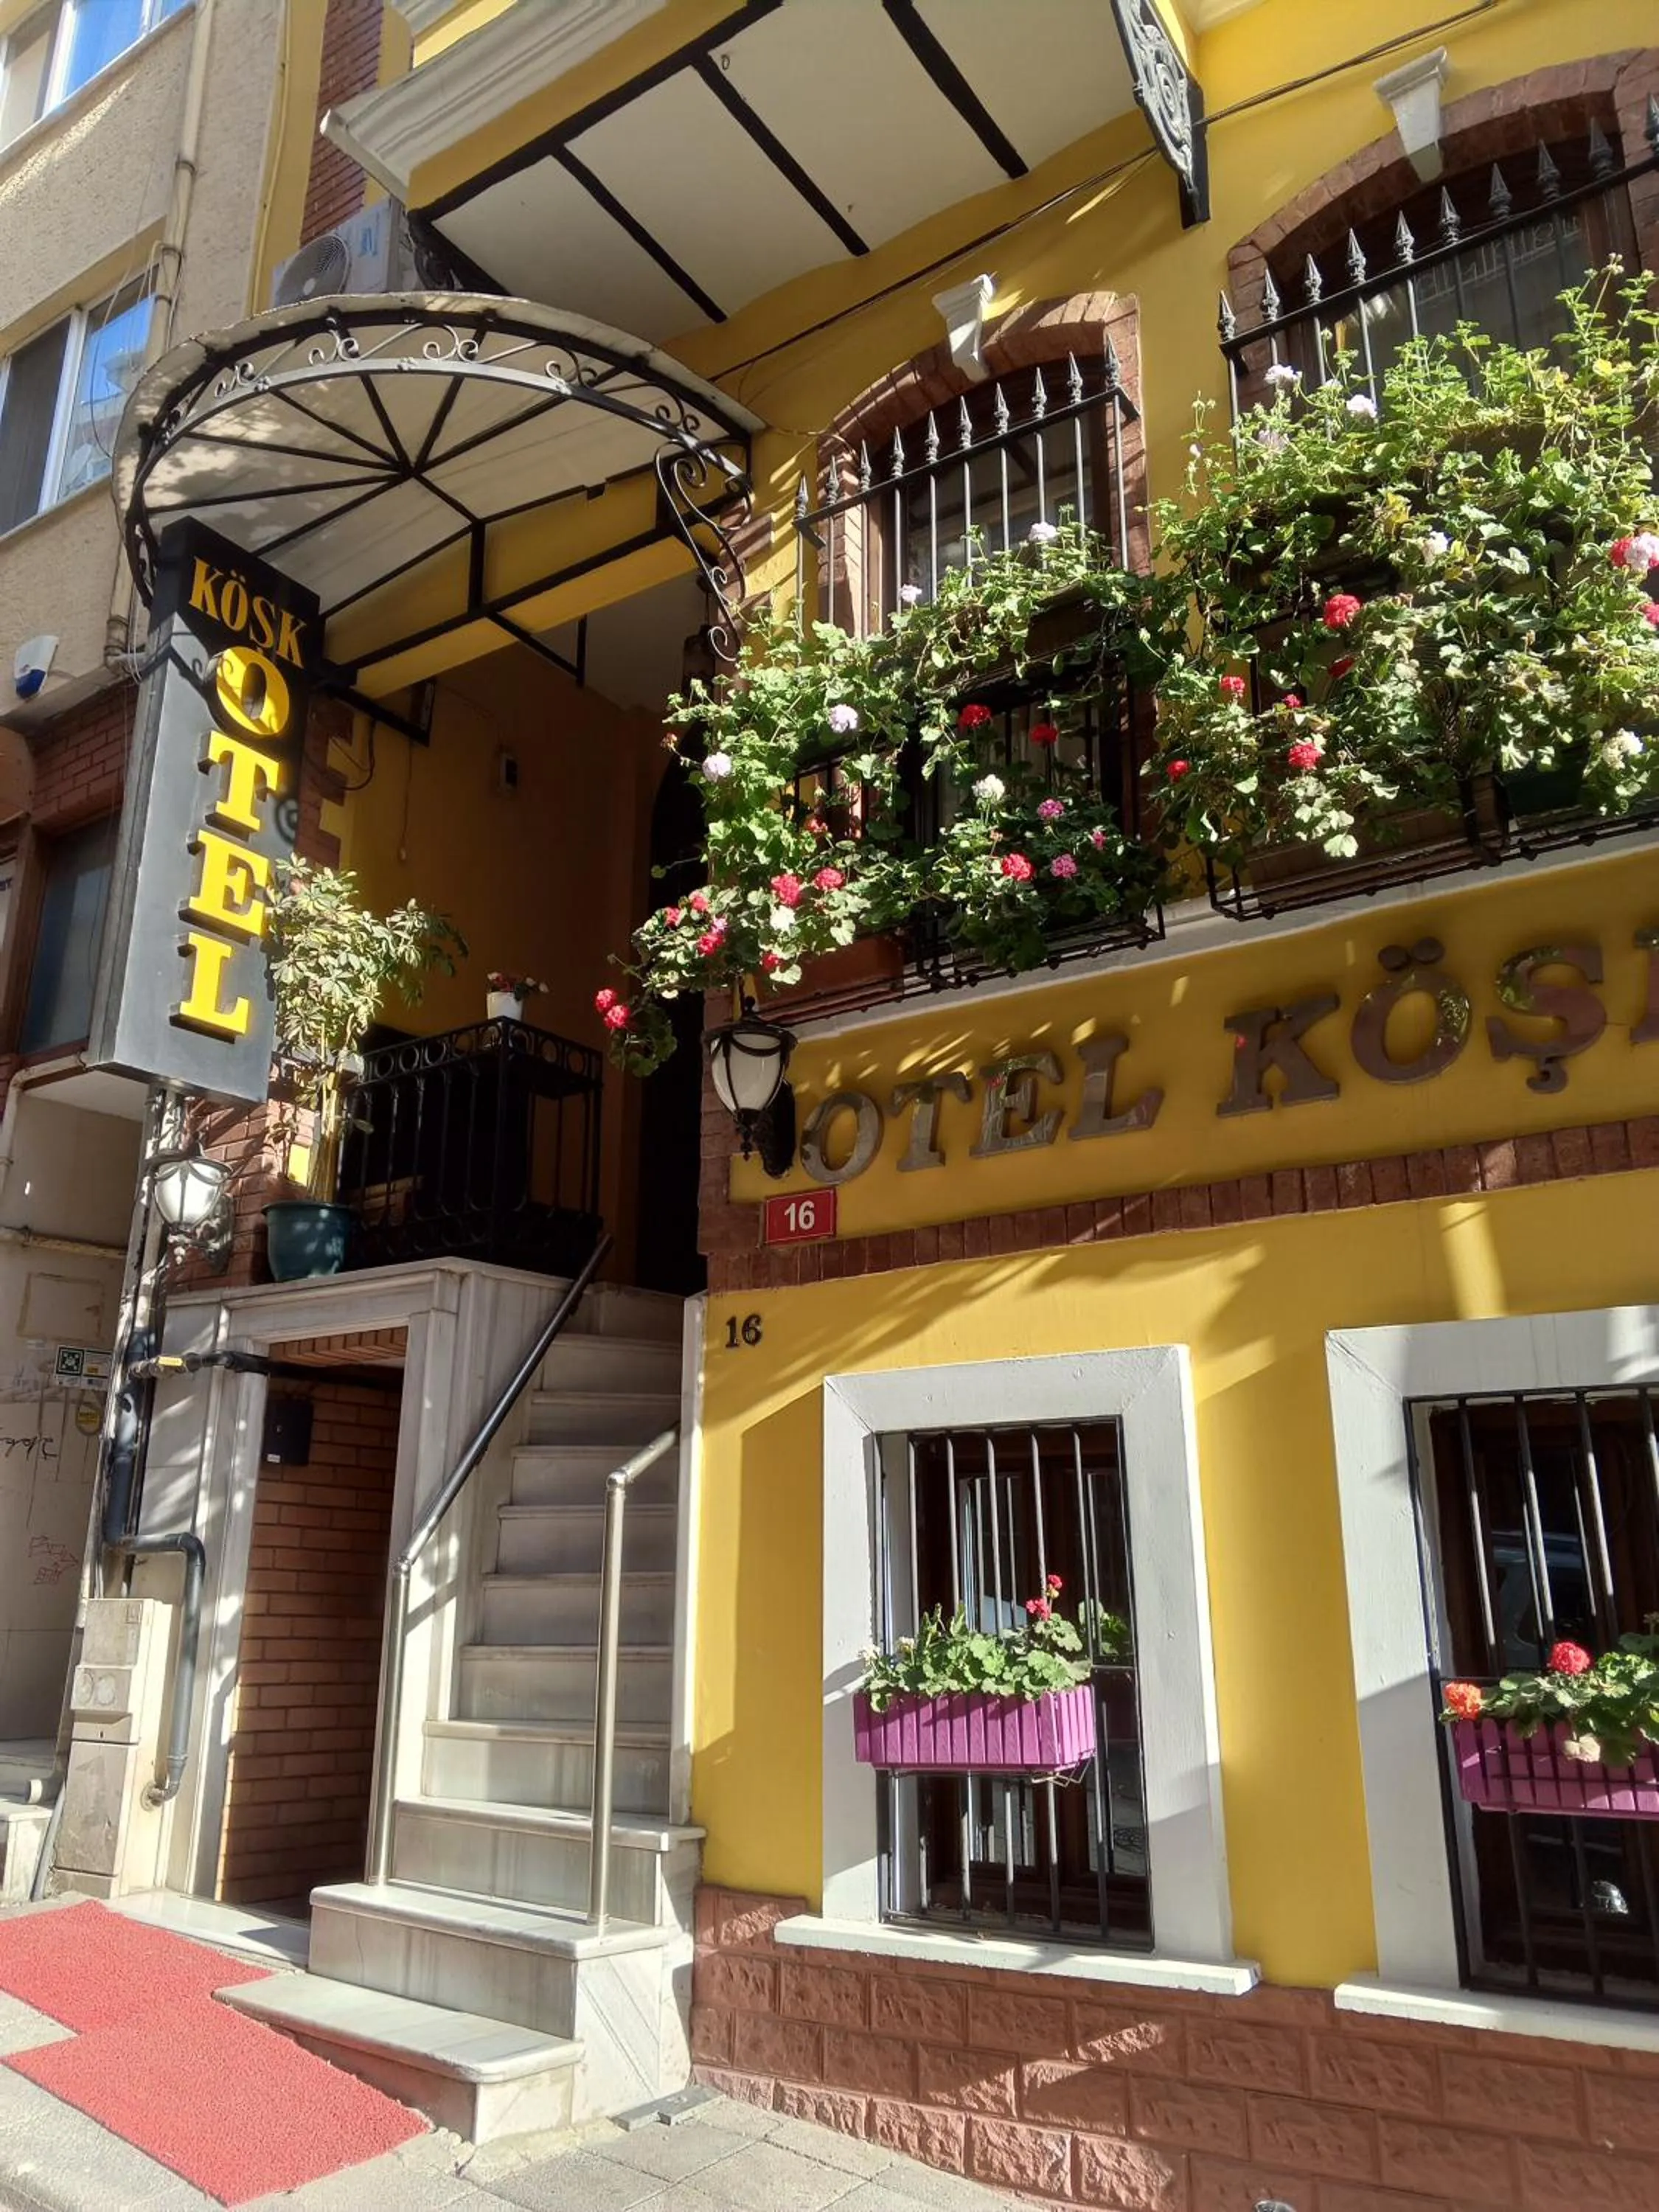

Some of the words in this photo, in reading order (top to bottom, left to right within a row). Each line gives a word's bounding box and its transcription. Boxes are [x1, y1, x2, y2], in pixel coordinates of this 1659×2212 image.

[177, 645, 291, 1038] OTEL
[799, 1033, 1165, 1185] OTEL
[784, 1200, 815, 1233] 16
[725, 1313, 762, 1349] 16
